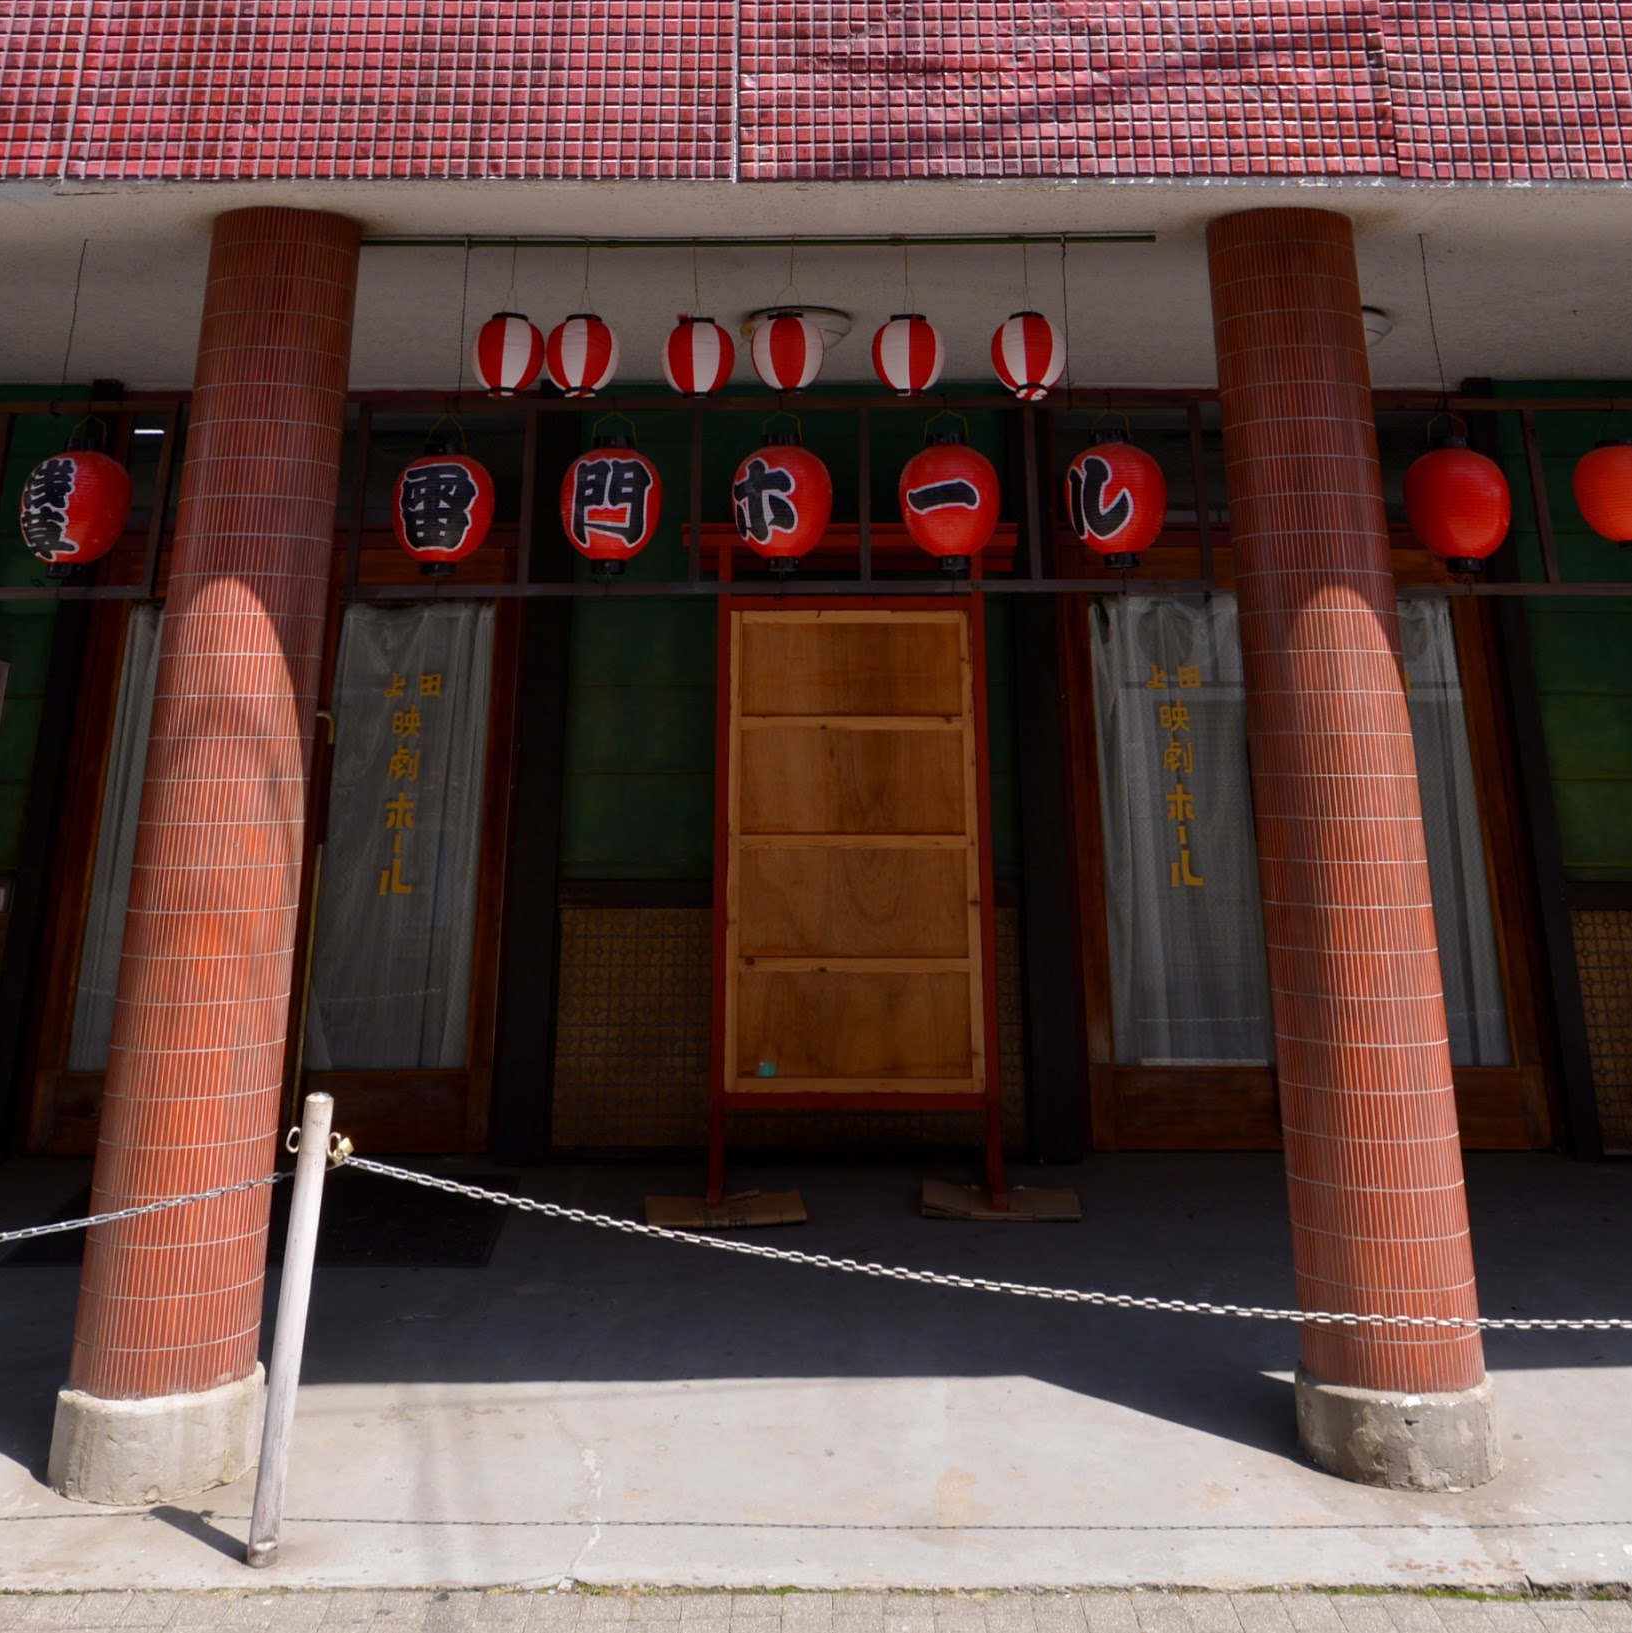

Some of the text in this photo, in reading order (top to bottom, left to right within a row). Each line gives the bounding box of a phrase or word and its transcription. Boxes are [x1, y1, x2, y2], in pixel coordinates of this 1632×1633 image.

[382, 671, 443, 698] 上田
[1145, 664, 1202, 689] 上田
[378, 703, 422, 896] 映劇ホール
[1158, 698, 1204, 888] 映劇ホール
